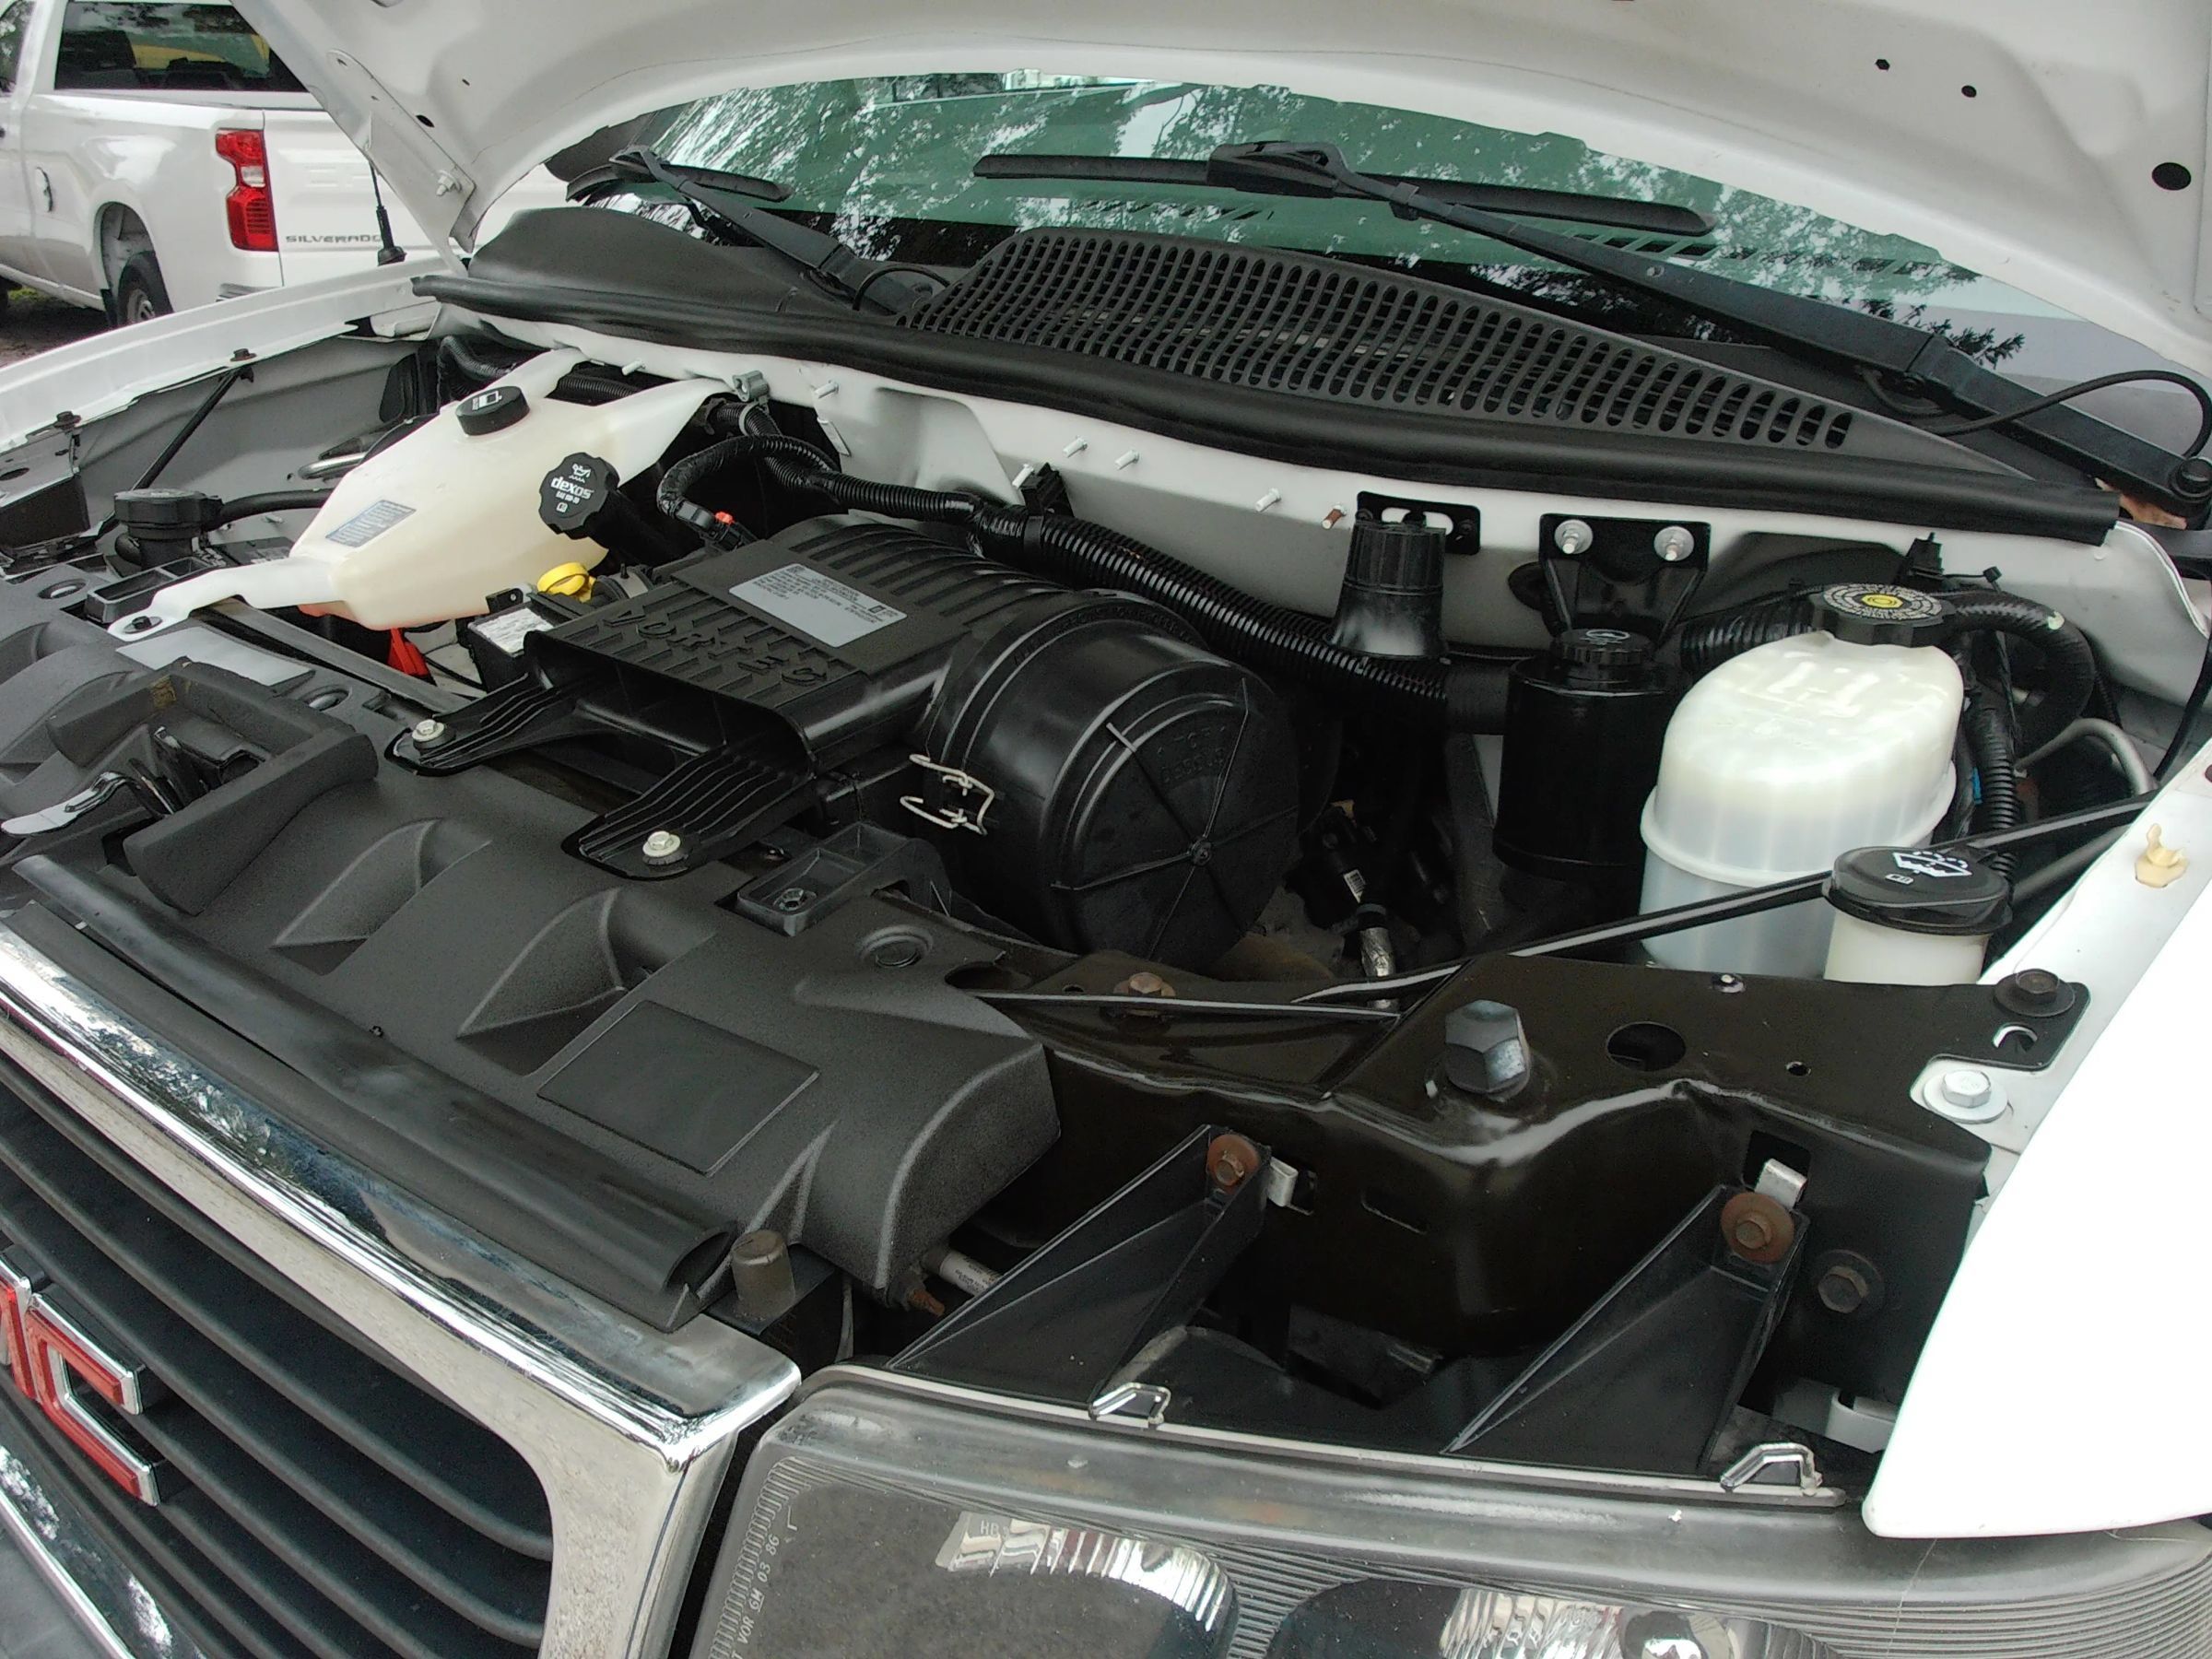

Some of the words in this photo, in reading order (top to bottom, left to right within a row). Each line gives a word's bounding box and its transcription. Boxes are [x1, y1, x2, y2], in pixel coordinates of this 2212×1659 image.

[286, 234, 383, 243] SILVERADO
[550, 476, 594, 500] dexos
[602, 608, 828, 688] VORTEC
[737, 1616, 755, 1644] VOR
[748, 1587, 765, 1612] GM
[758, 1561, 771, 1583] 03
